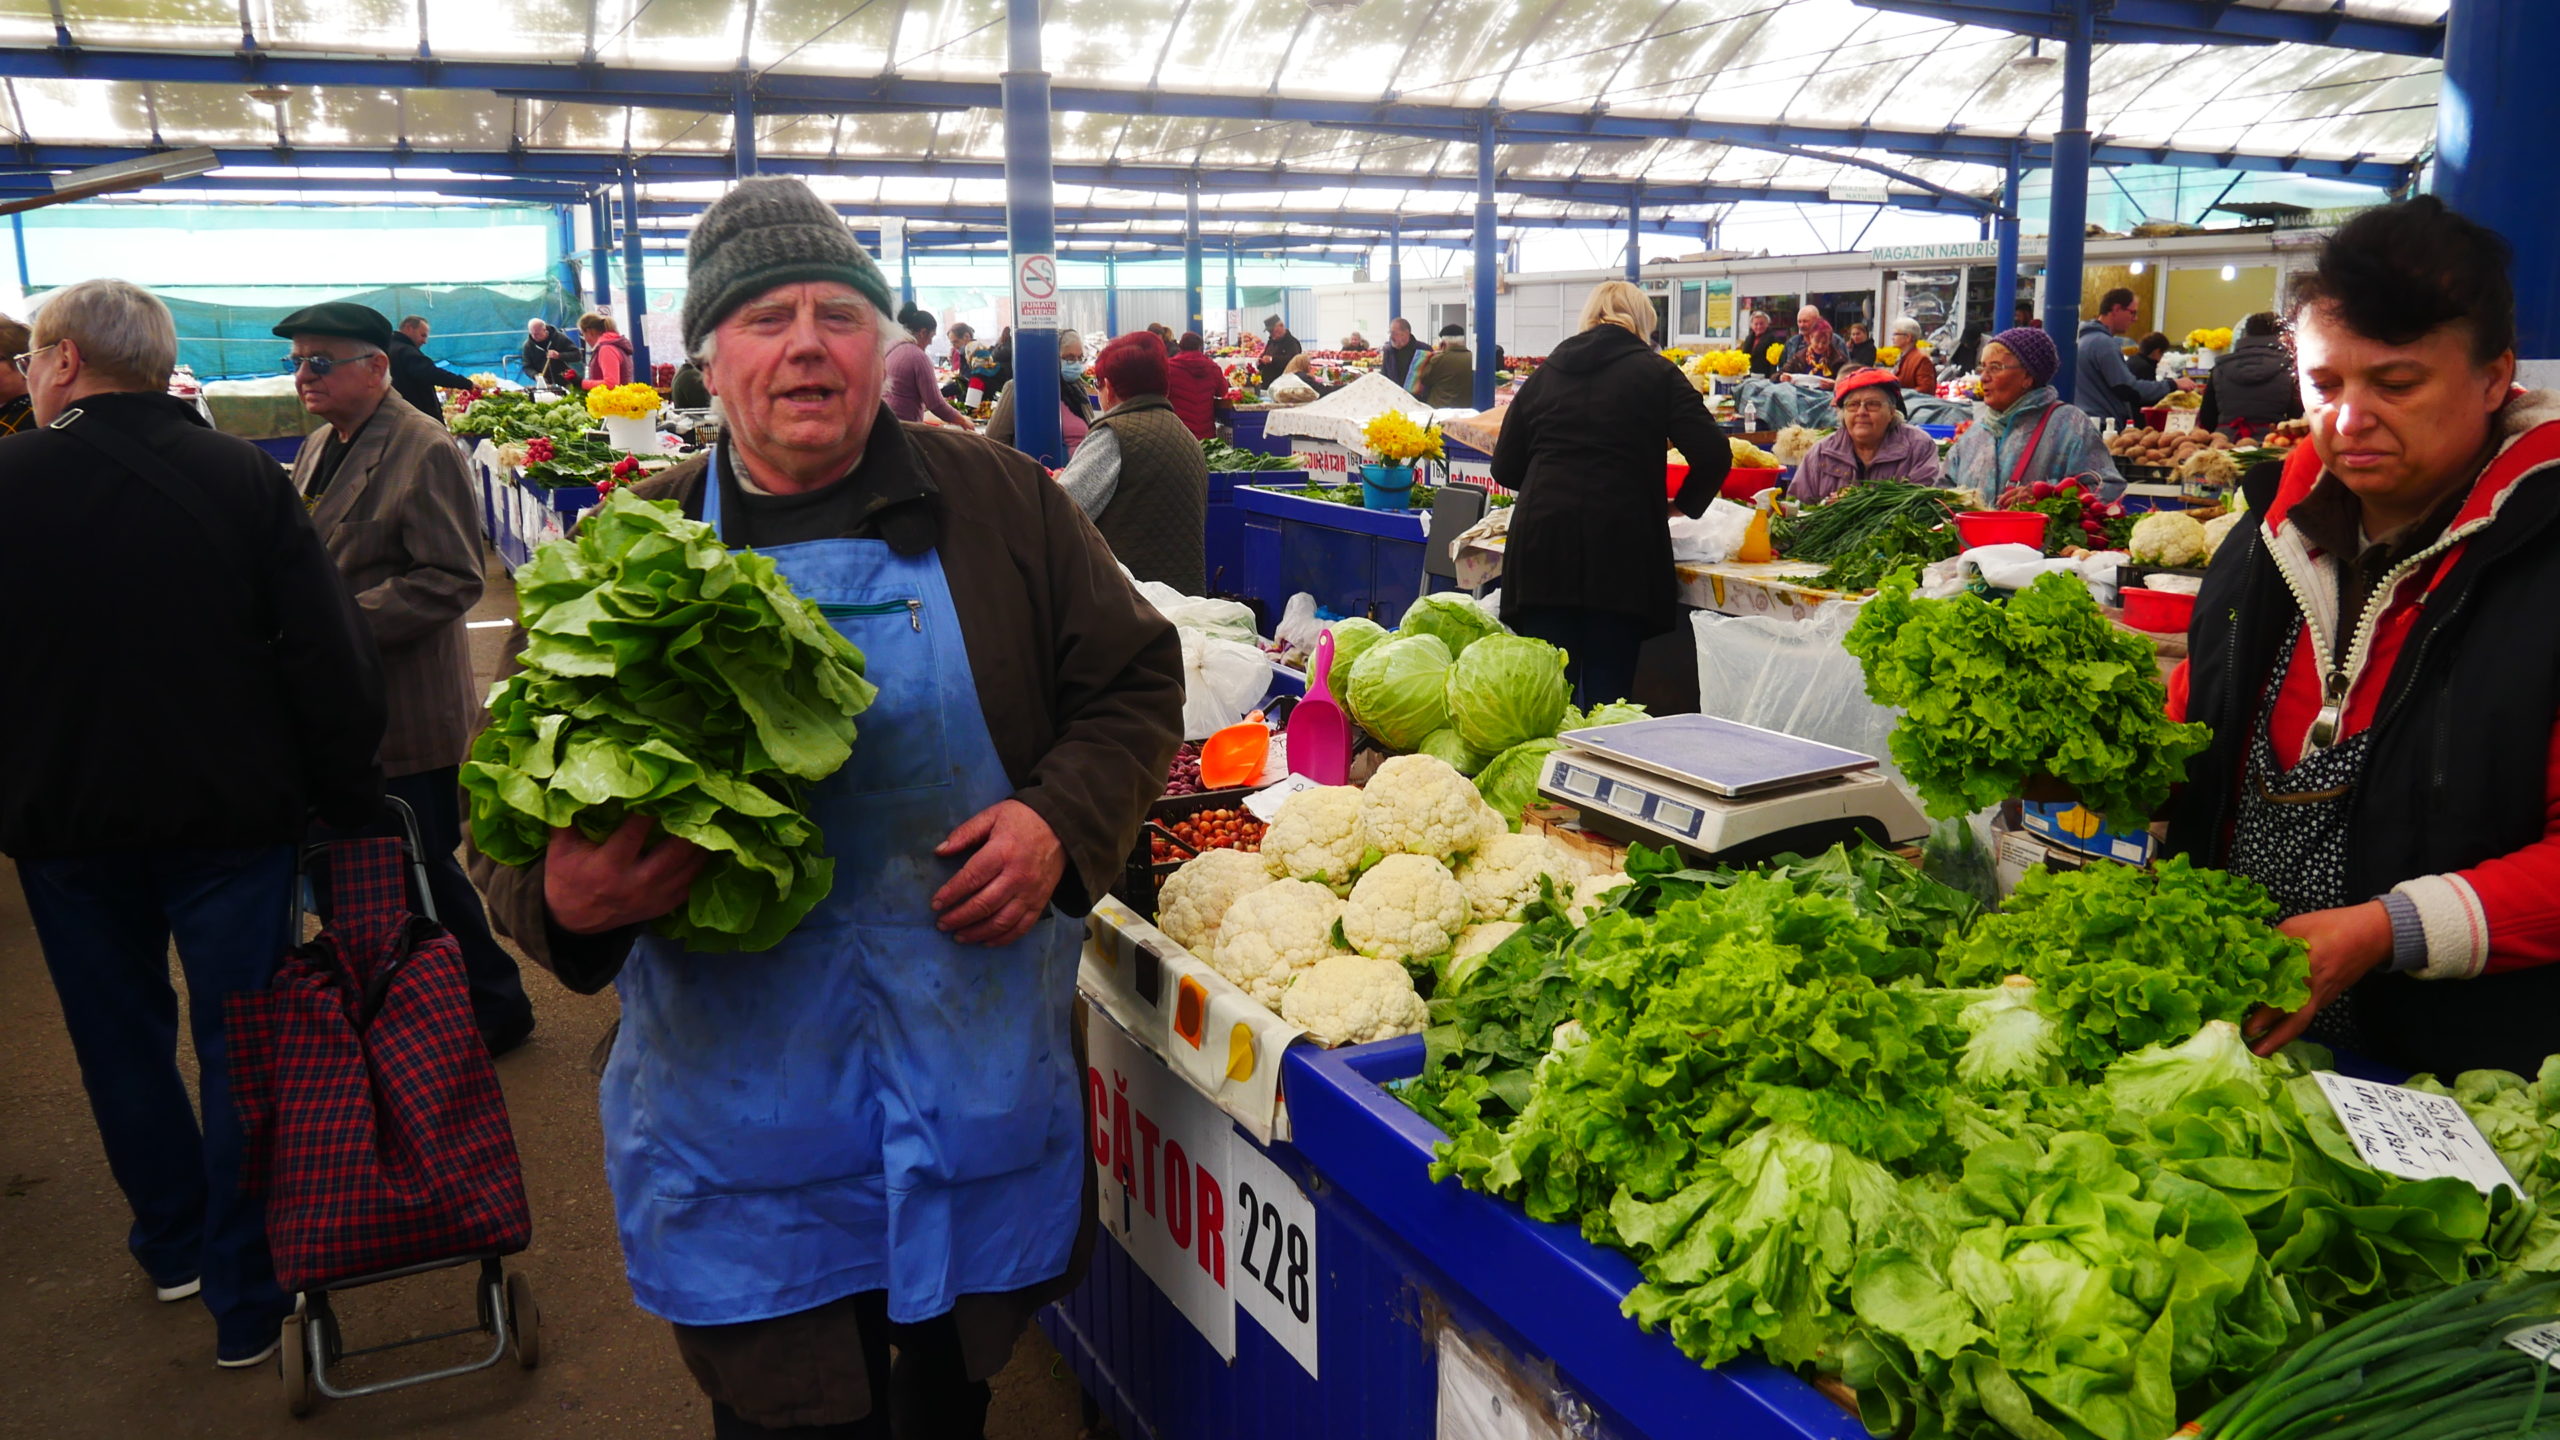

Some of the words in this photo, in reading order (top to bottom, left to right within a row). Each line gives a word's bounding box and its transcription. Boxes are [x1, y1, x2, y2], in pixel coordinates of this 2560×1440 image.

[2279, 213, 2332, 227] MAGAZIN
[1873, 247, 1935, 260] MAGAZIN
[1239, 1182, 1310, 1324] 228
